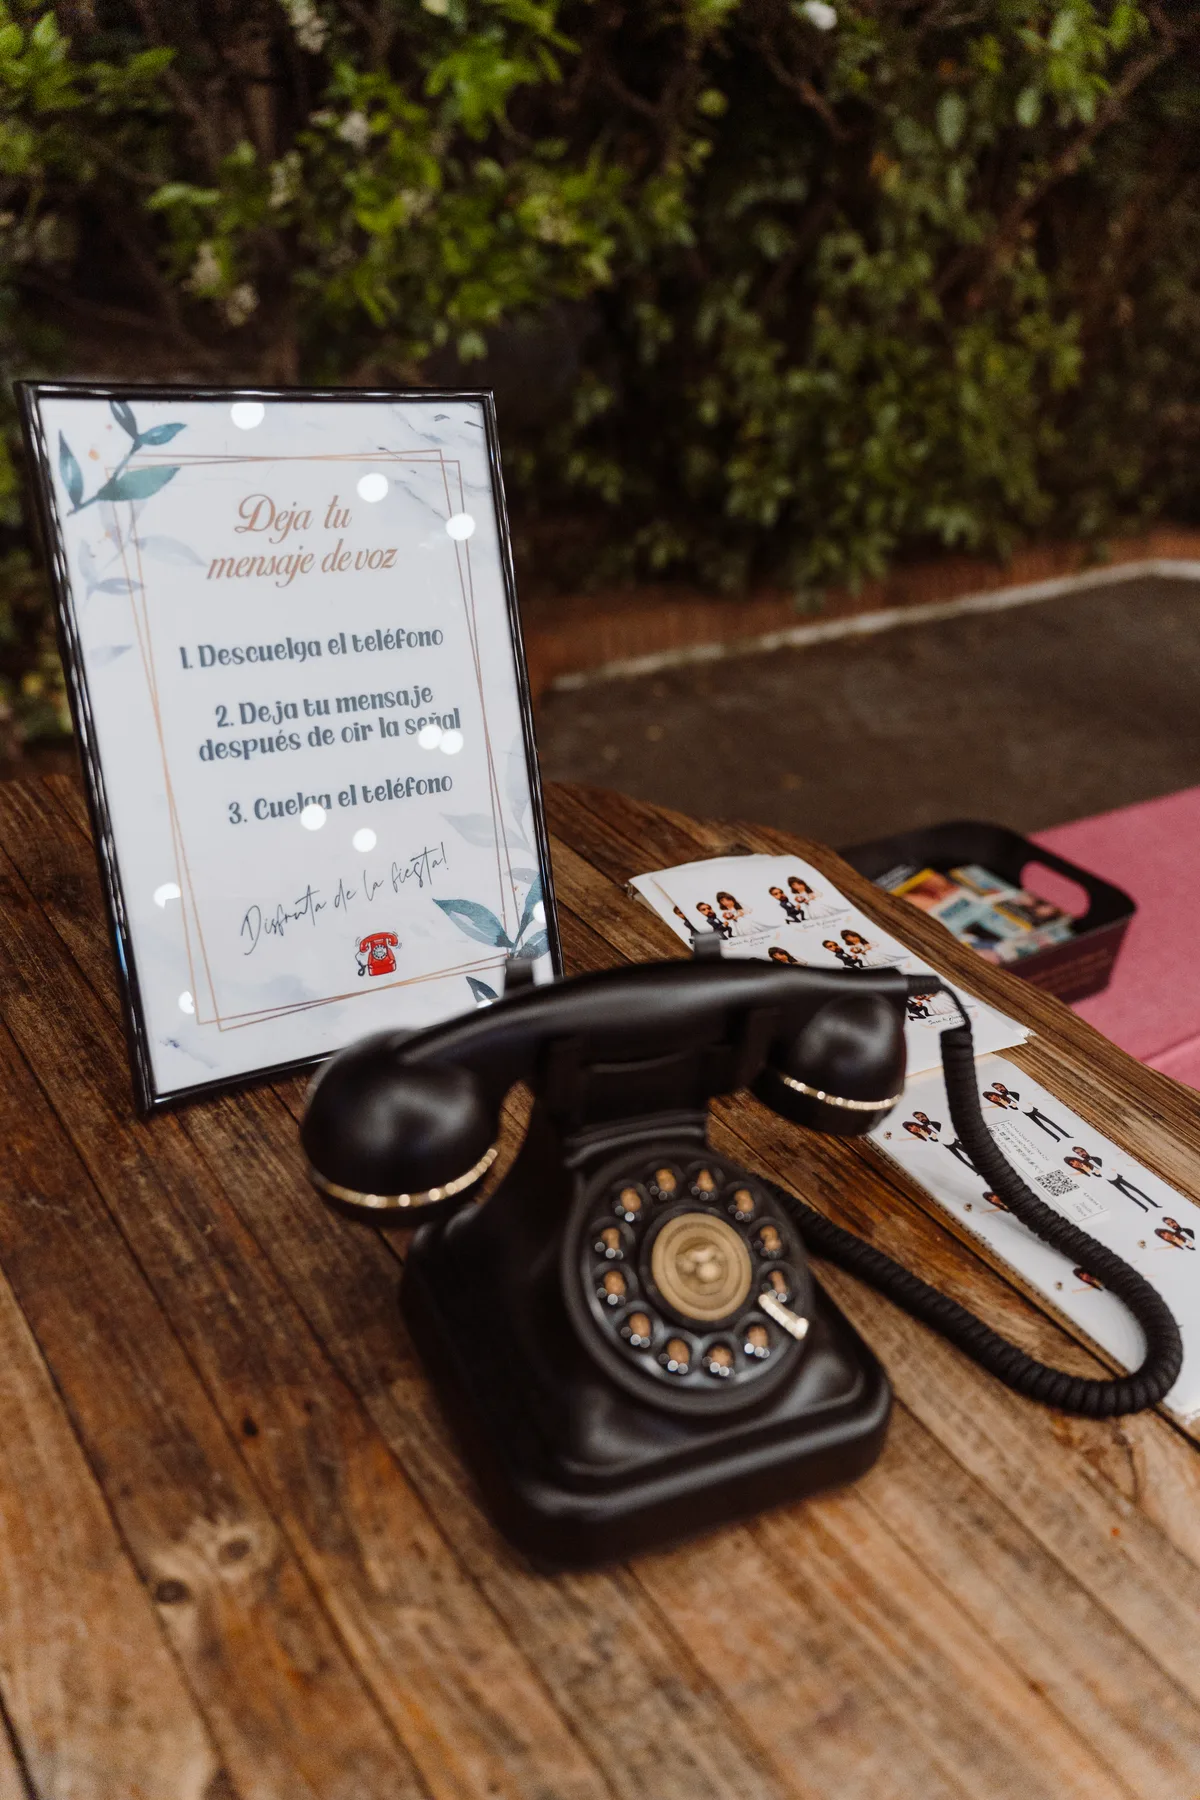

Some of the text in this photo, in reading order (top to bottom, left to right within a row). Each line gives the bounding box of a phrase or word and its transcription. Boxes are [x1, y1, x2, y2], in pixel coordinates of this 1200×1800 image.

[234, 493, 352, 545] Deja tu
[206, 538, 399, 588] mensaje de voz
[198, 637, 322, 668] Descuelga
[327, 632, 347, 655] el
[351, 628, 444, 653] teléfono
[215, 685, 434, 728] 2. Deja tu mensaje
[199, 730, 301, 762] después
[307, 726, 335, 748] de
[341, 722, 373, 743] oir
[378, 717, 400, 738] la
[228, 802, 248, 825] 3.
[338, 784, 358, 807] el
[361, 775, 453, 803] teléfono
[240, 885, 327, 956] Disfruta
[334, 879, 356, 912] de
[391, 841, 450, 892] fiesta!
